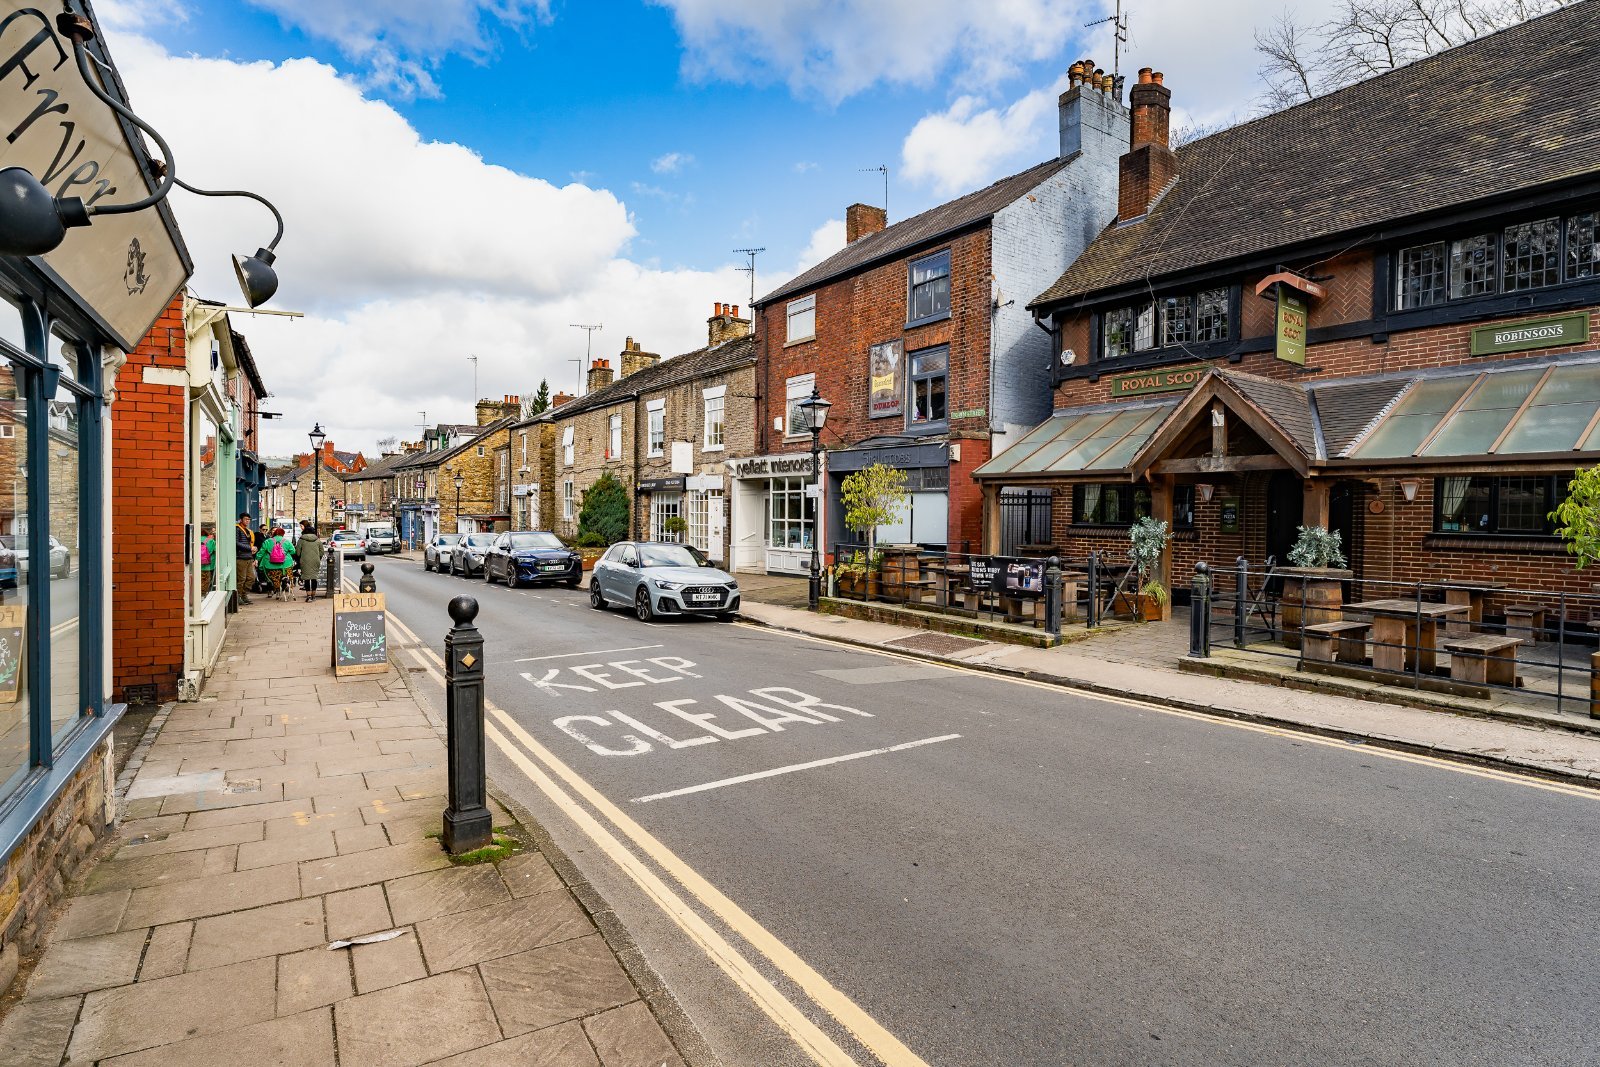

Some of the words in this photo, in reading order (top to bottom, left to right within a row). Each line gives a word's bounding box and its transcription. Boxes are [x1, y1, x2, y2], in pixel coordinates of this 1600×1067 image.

[1282, 311, 1304, 327] ROYAL
[1283, 327, 1302, 340] SCOT
[1494, 326, 1564, 343] ROBINSONS
[1121, 376, 1163, 391] ROYAL
[1166, 370, 1202, 385] SCOT
[873, 400, 900, 411] DUNLOP
[342, 598, 377, 609] FOLD
[519, 655, 704, 697] KEEP
[552, 686, 876, 757] CLEAR
